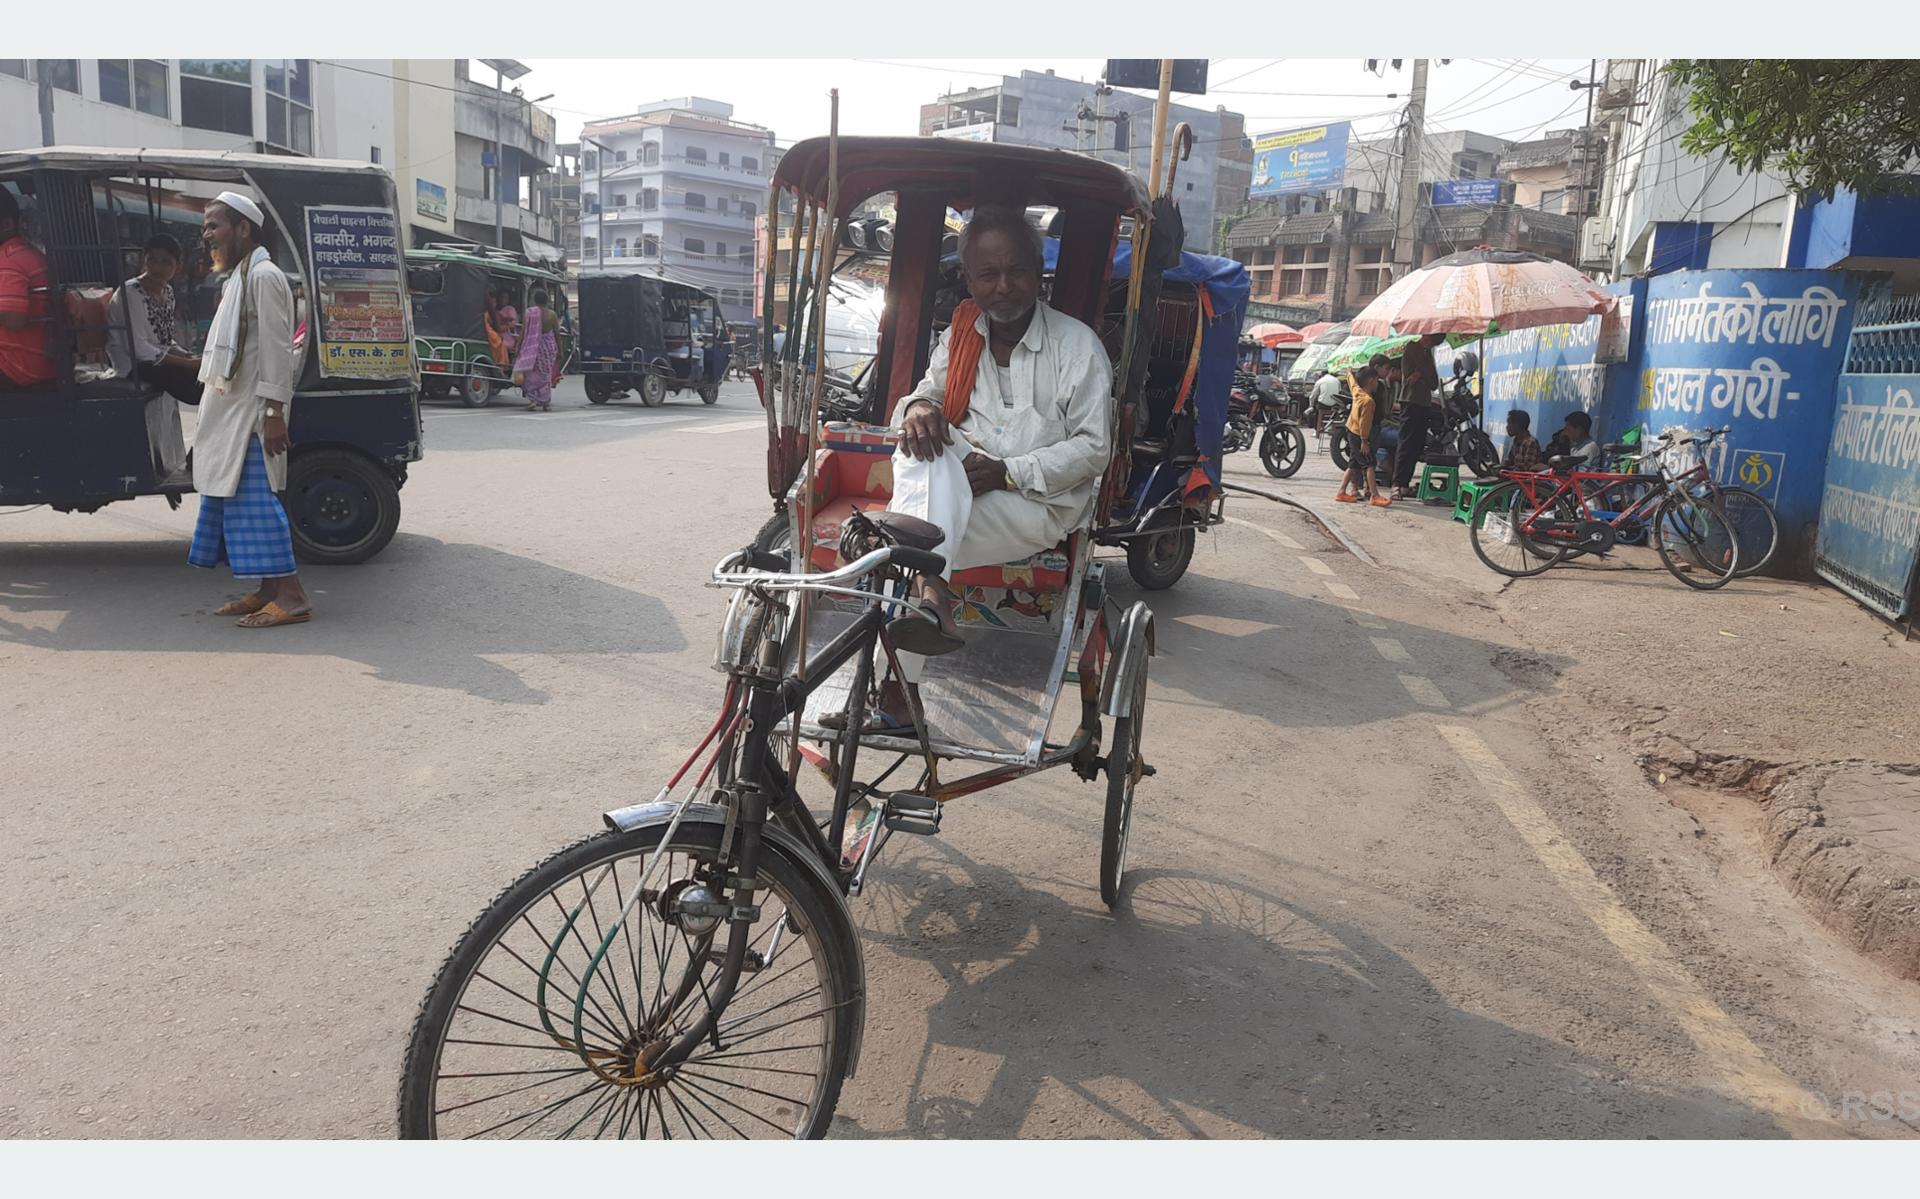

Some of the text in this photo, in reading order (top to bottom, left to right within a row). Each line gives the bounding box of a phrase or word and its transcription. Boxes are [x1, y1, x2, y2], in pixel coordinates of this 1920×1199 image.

[313, 228, 359, 248] बवासीर,
[1762, 286, 1847, 348] लागि
[329, 347, 345, 358] डॉ.
[1710, 357, 1791, 419] गरी
[1834, 385, 1878, 460] नेपाल
